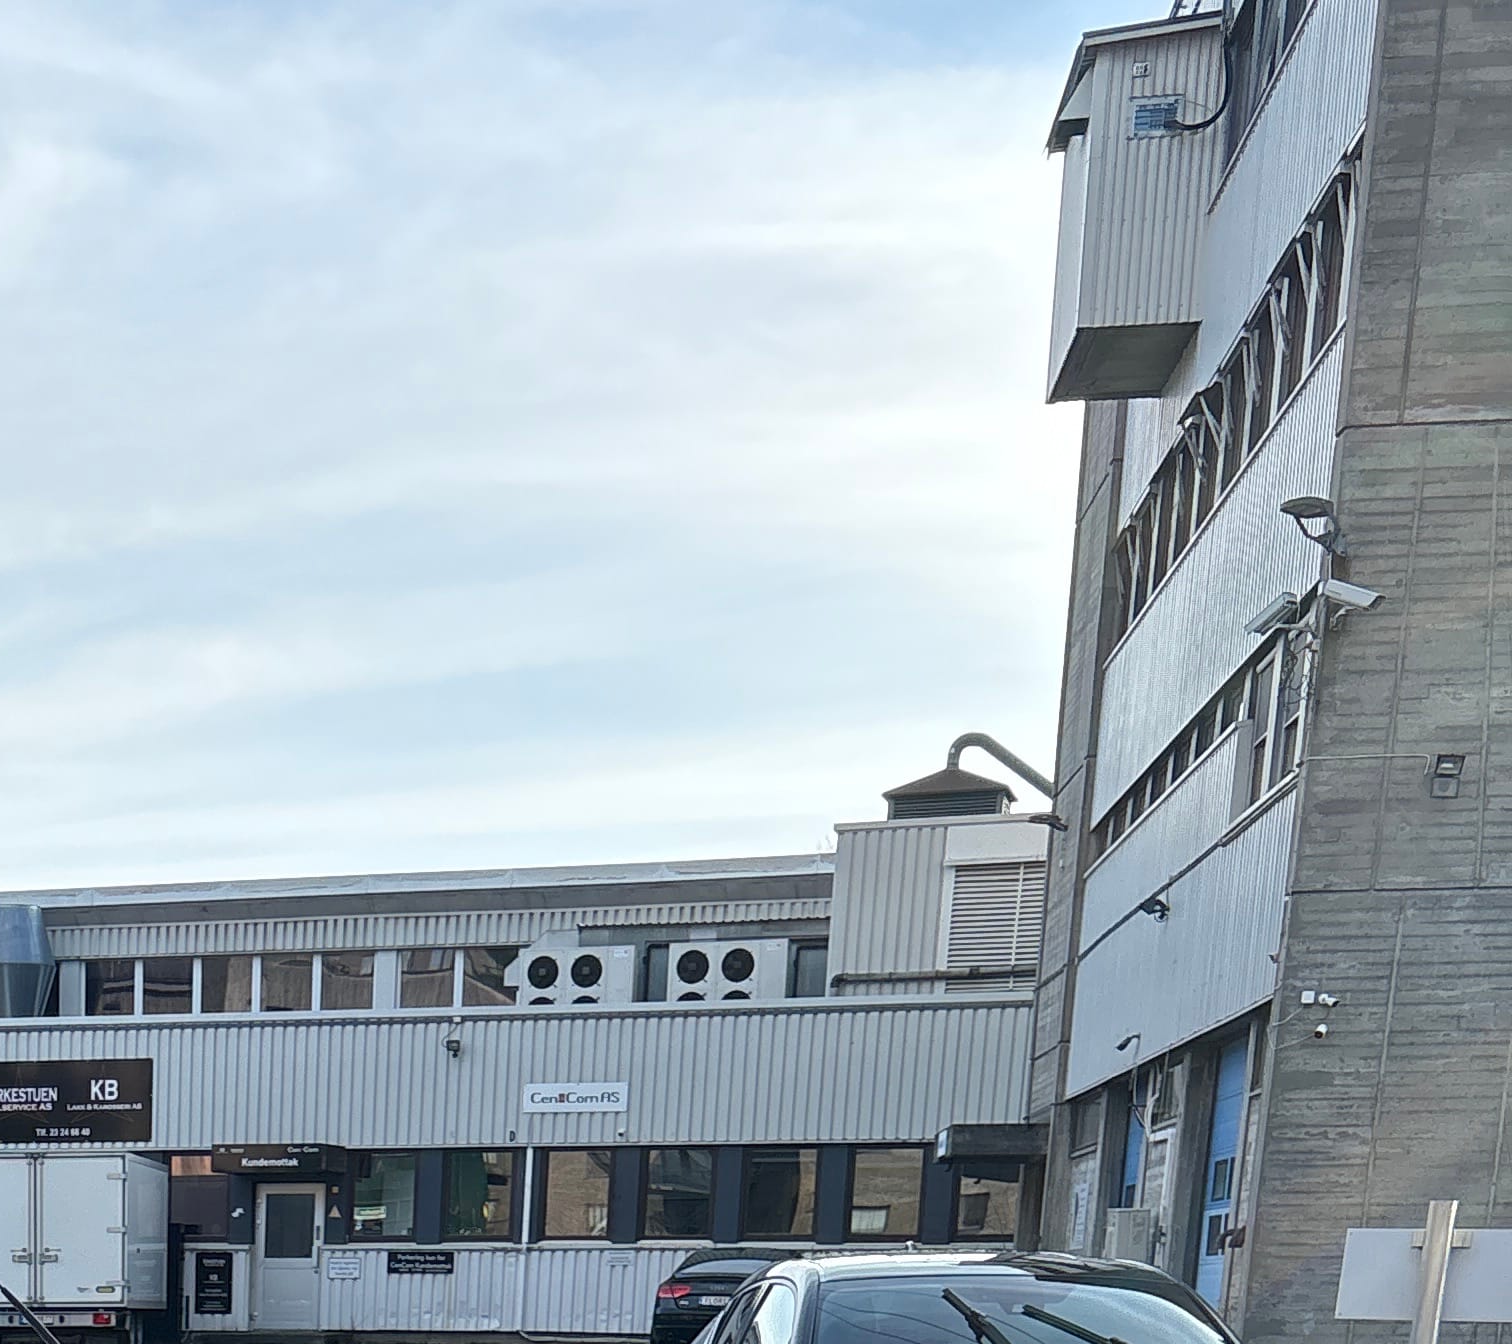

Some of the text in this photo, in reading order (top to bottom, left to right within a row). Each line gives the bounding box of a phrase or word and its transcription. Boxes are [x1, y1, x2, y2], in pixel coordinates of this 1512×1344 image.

[90, 1079, 119, 1101] KB
[39, 1103, 53, 1111] AS
[241, 1158, 299, 1167] Kundemottak
